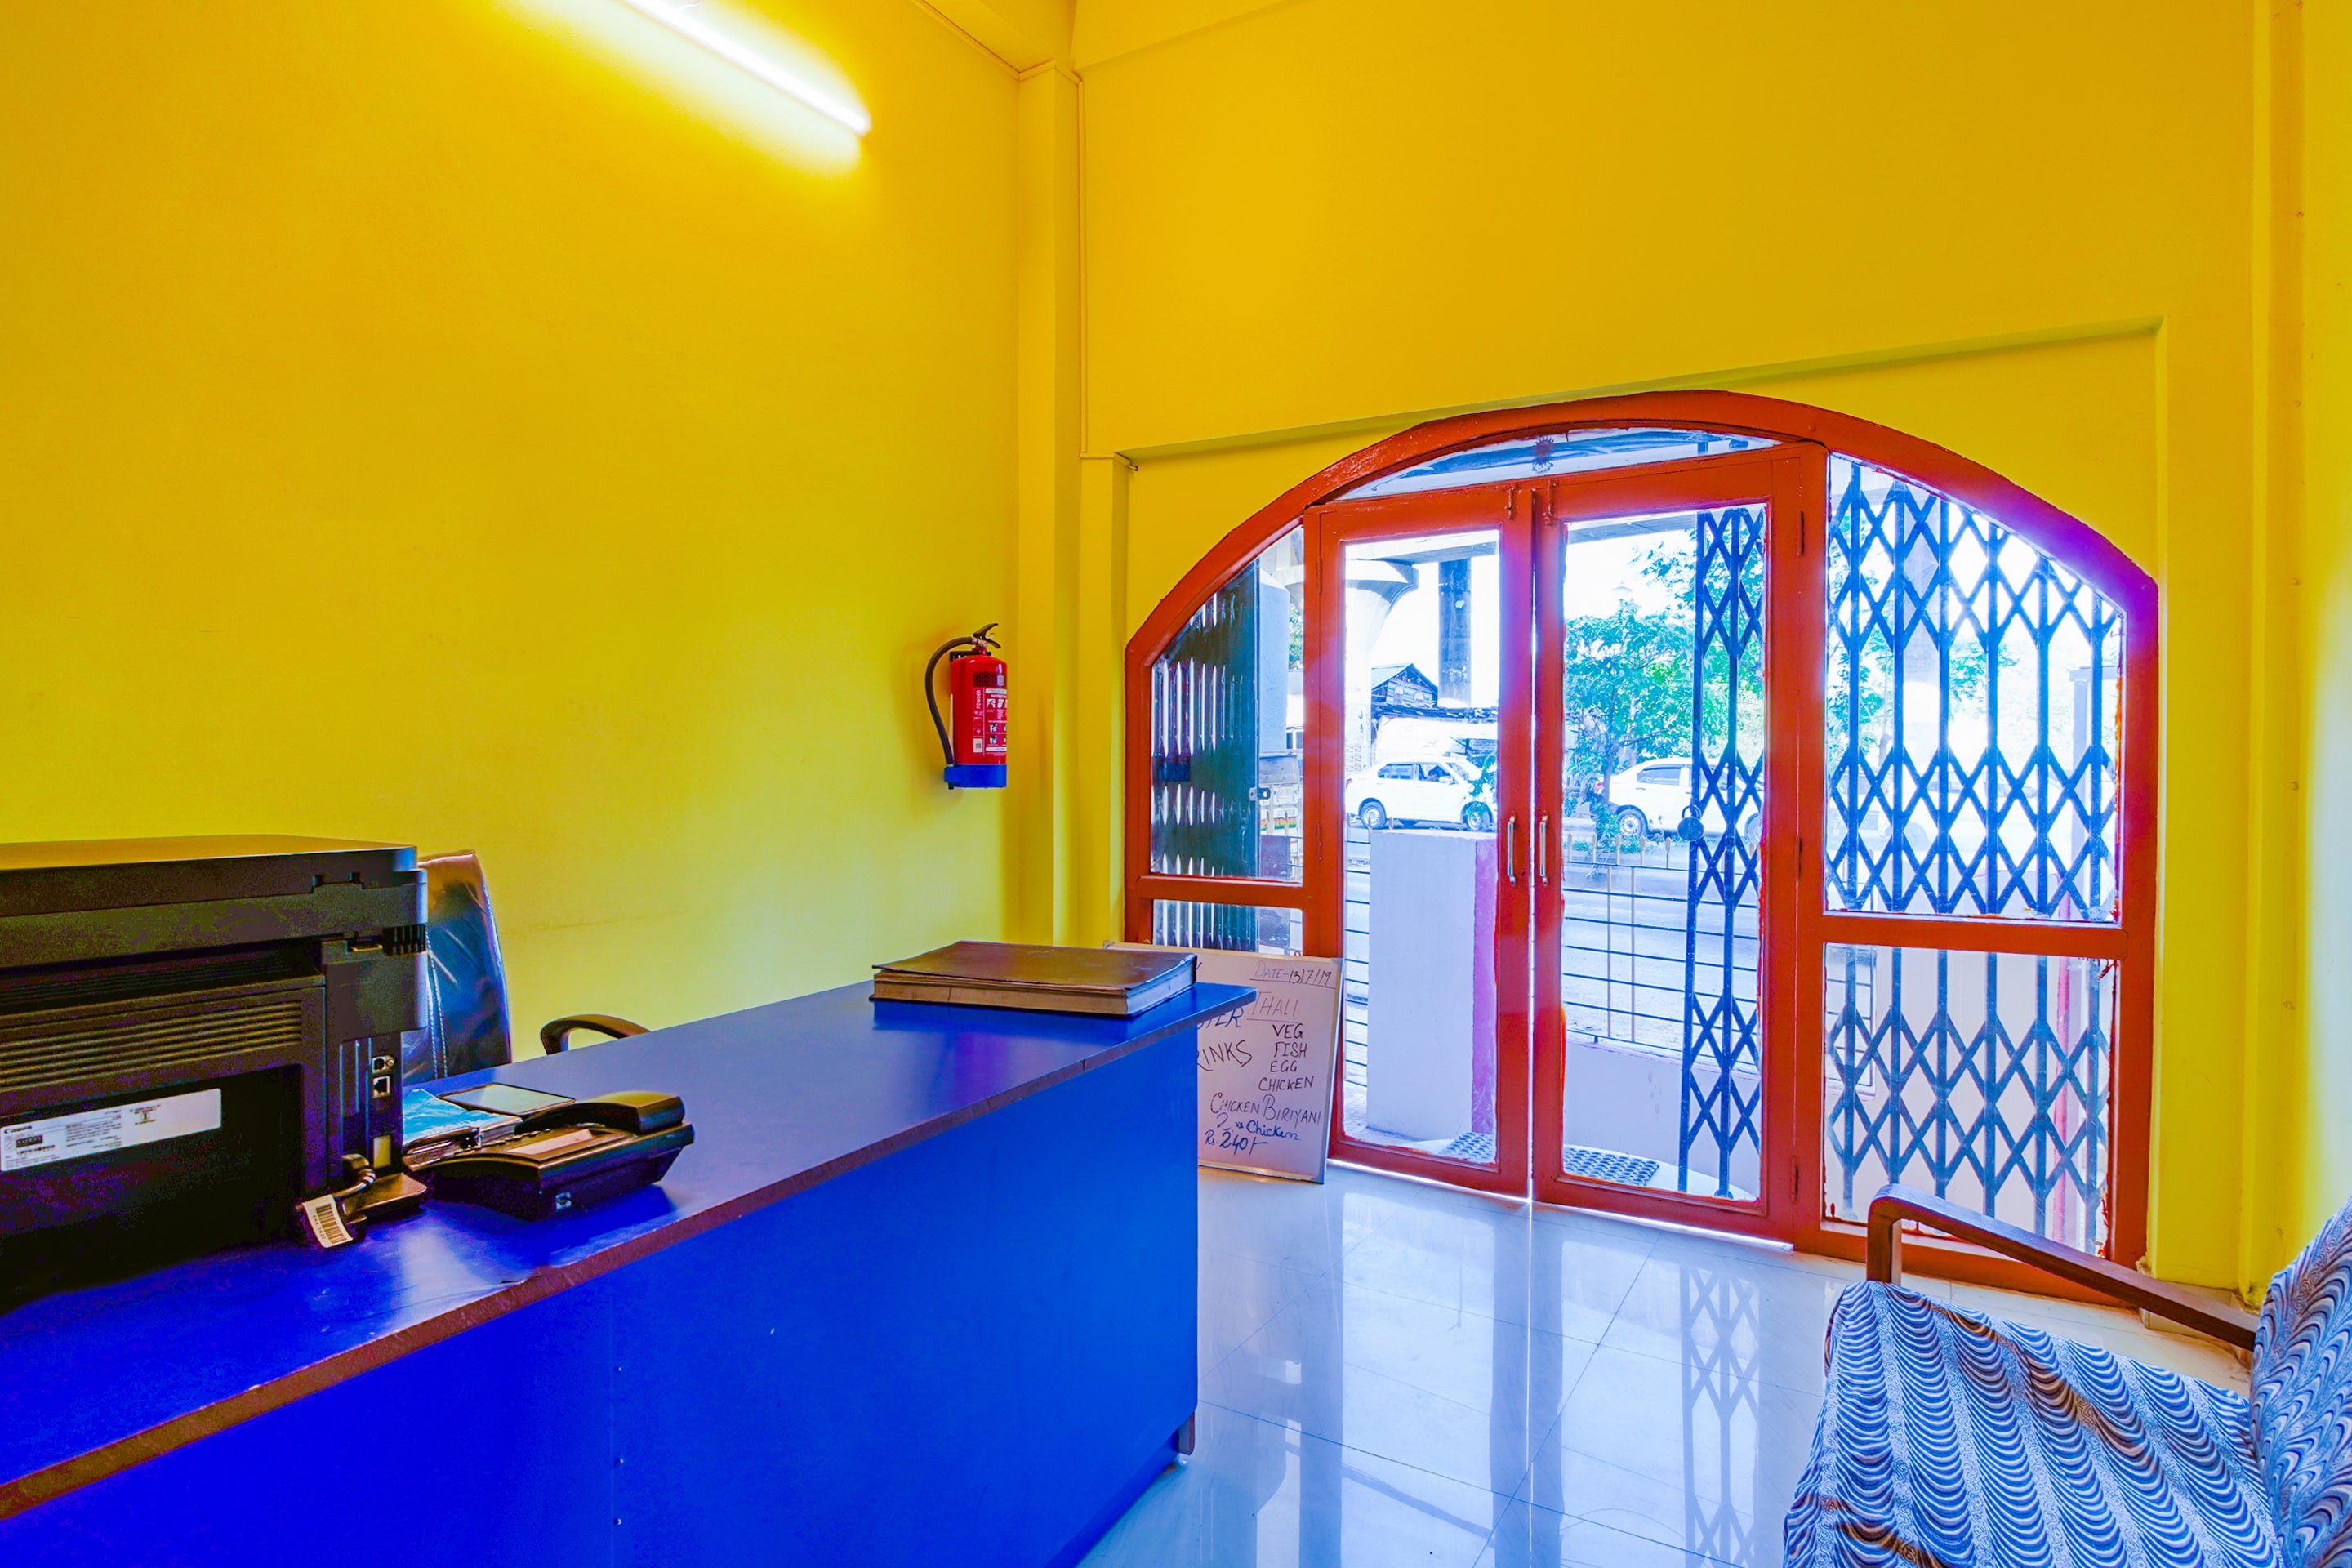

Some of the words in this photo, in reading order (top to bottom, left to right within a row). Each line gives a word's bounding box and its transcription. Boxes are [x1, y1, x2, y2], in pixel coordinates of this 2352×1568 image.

[1251, 991, 1299, 1017] THALI
[1272, 1022, 1303, 1039] VEG
[1273, 1041, 1308, 1058] FISH
[1270, 1061, 1298, 1073] EGG
[1258, 1076, 1314, 1092] CHICKEN
[1209, 1092, 1260, 1114] CHICKEN
[1263, 1094, 1322, 1129] BIRIYANI
[1245, 1120, 1302, 1141] Chicken
